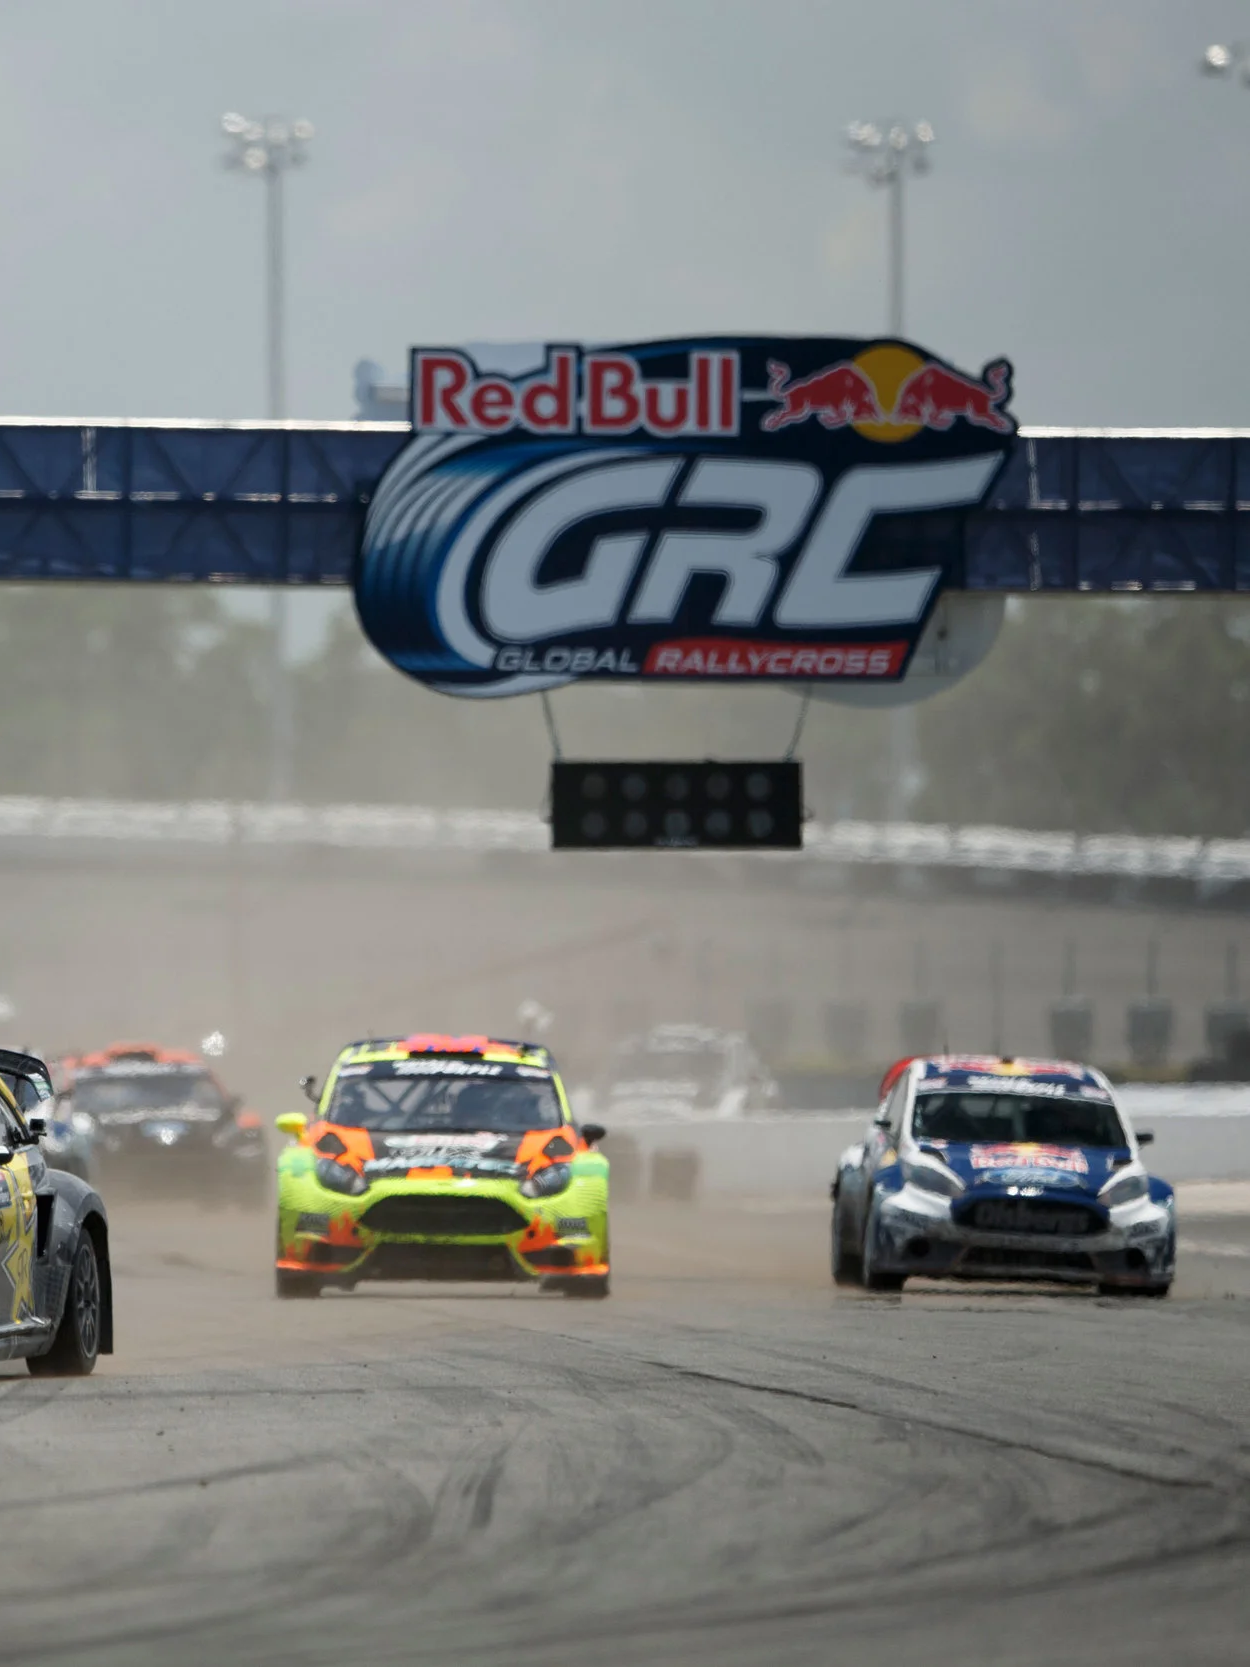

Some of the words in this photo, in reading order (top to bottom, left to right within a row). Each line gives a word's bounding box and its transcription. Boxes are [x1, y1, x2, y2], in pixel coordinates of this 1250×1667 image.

[417, 352, 572, 431] Red
[586, 353, 736, 433] Bull
[482, 451, 1006, 643] GRC
[496, 647, 639, 675] GLOBAL
[654, 648, 893, 676] RALLYCROSS
